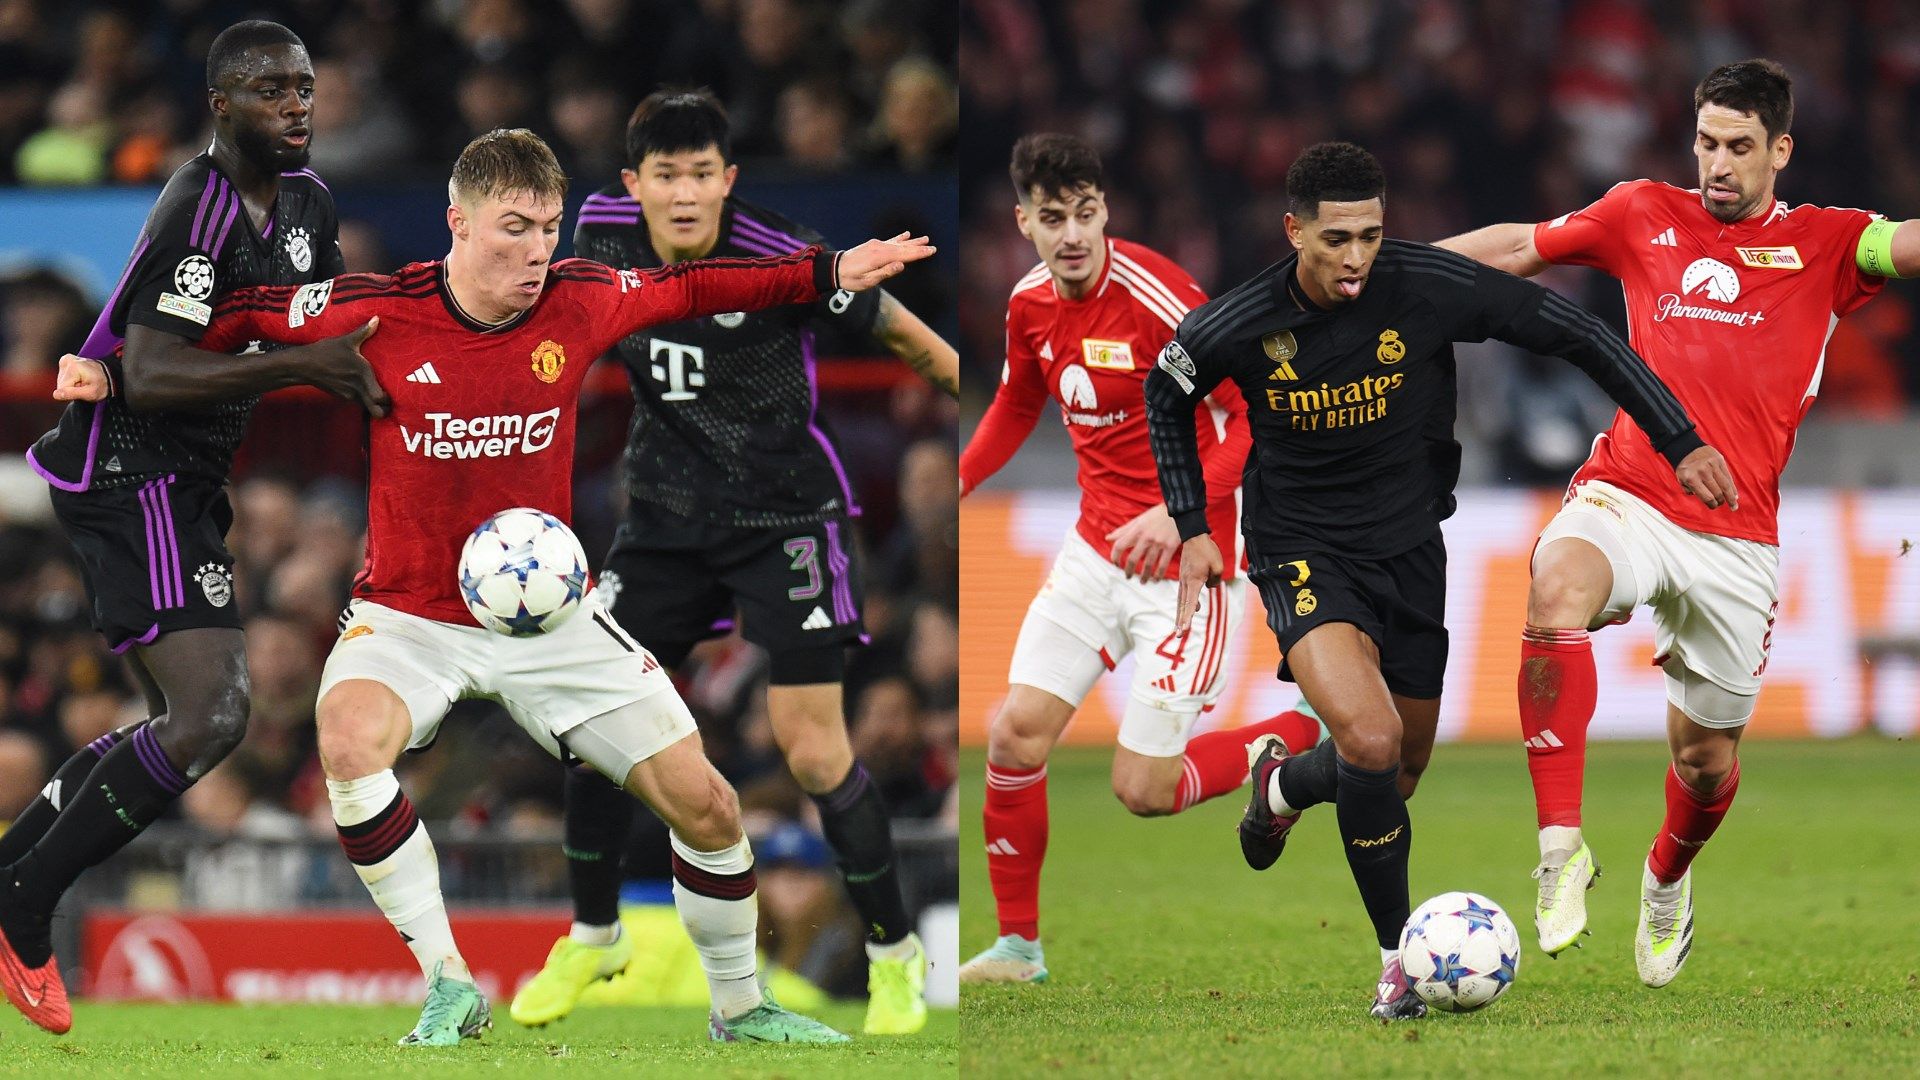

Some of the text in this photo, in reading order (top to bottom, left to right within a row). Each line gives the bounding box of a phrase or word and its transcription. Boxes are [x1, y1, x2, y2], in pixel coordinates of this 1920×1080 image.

[649, 337, 706, 401] T
[1265, 373, 1404, 413] Emirates
[424, 412, 523, 440] Team
[1291, 397, 1388, 432] FLY BETTER
[399, 424, 520, 460] Viewer
[783, 535, 824, 602] 3
[1155, 628, 1192, 671] 4
[1352, 824, 1404, 848] RMCF
